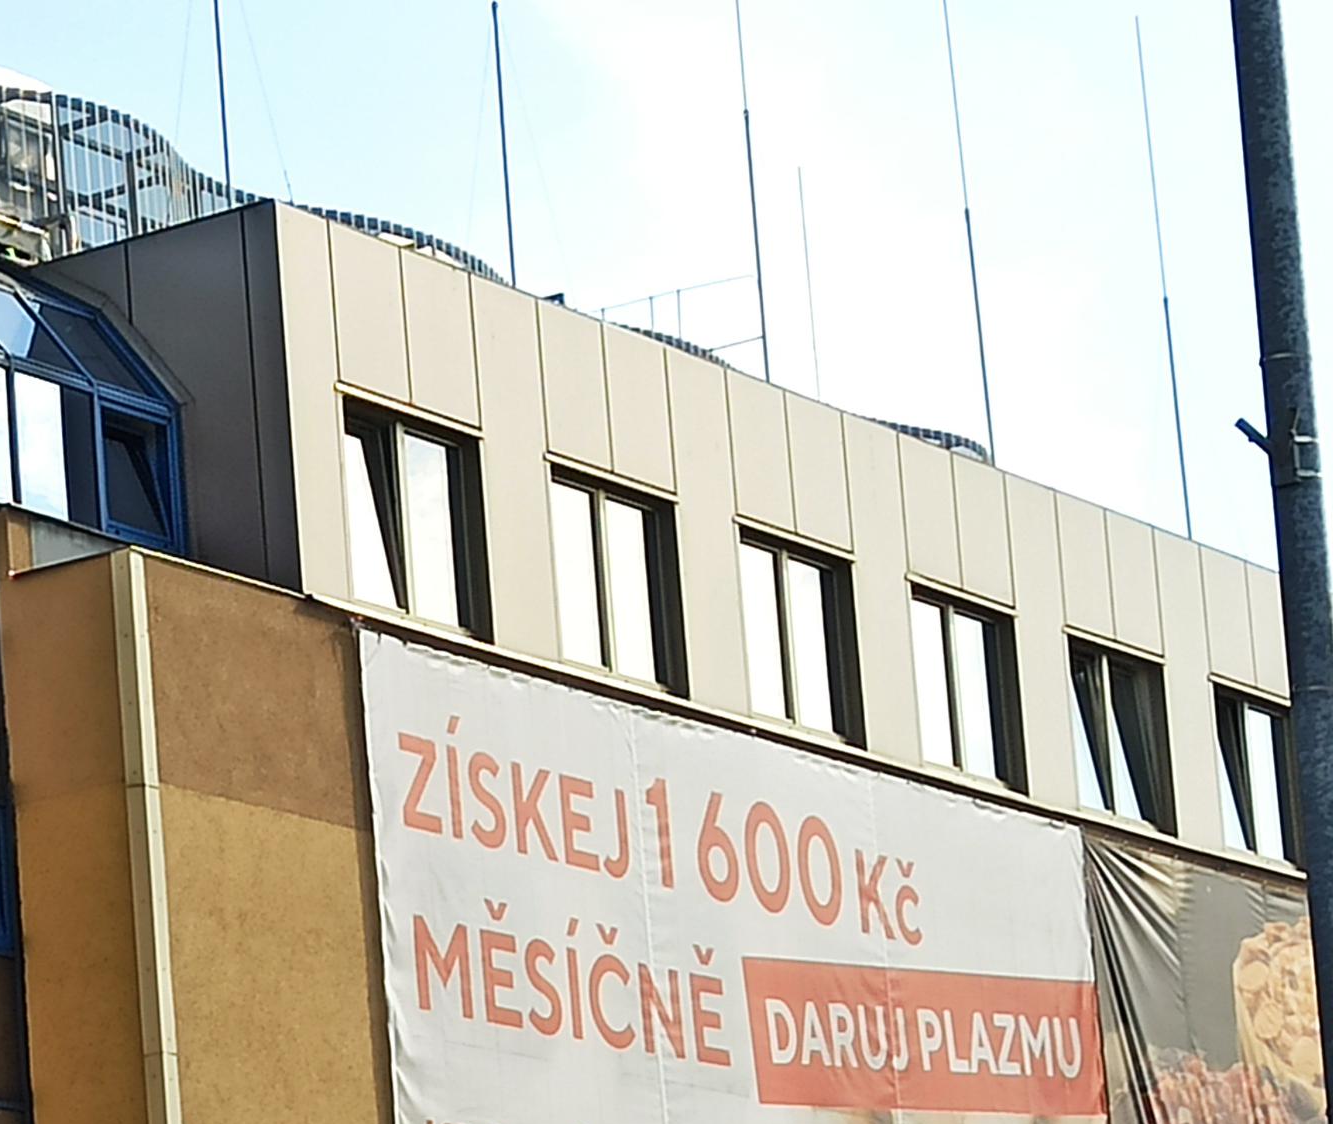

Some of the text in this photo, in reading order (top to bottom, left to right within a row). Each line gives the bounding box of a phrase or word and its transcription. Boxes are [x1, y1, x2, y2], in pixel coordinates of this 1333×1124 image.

[398, 716, 628, 880] ZÍSKEJ
[855, 848, 923, 946] Kč
[413, 898, 731, 1067] MĚSÍČNĚ
[765, 998, 1082, 1080] DARUJ PLAZMU
